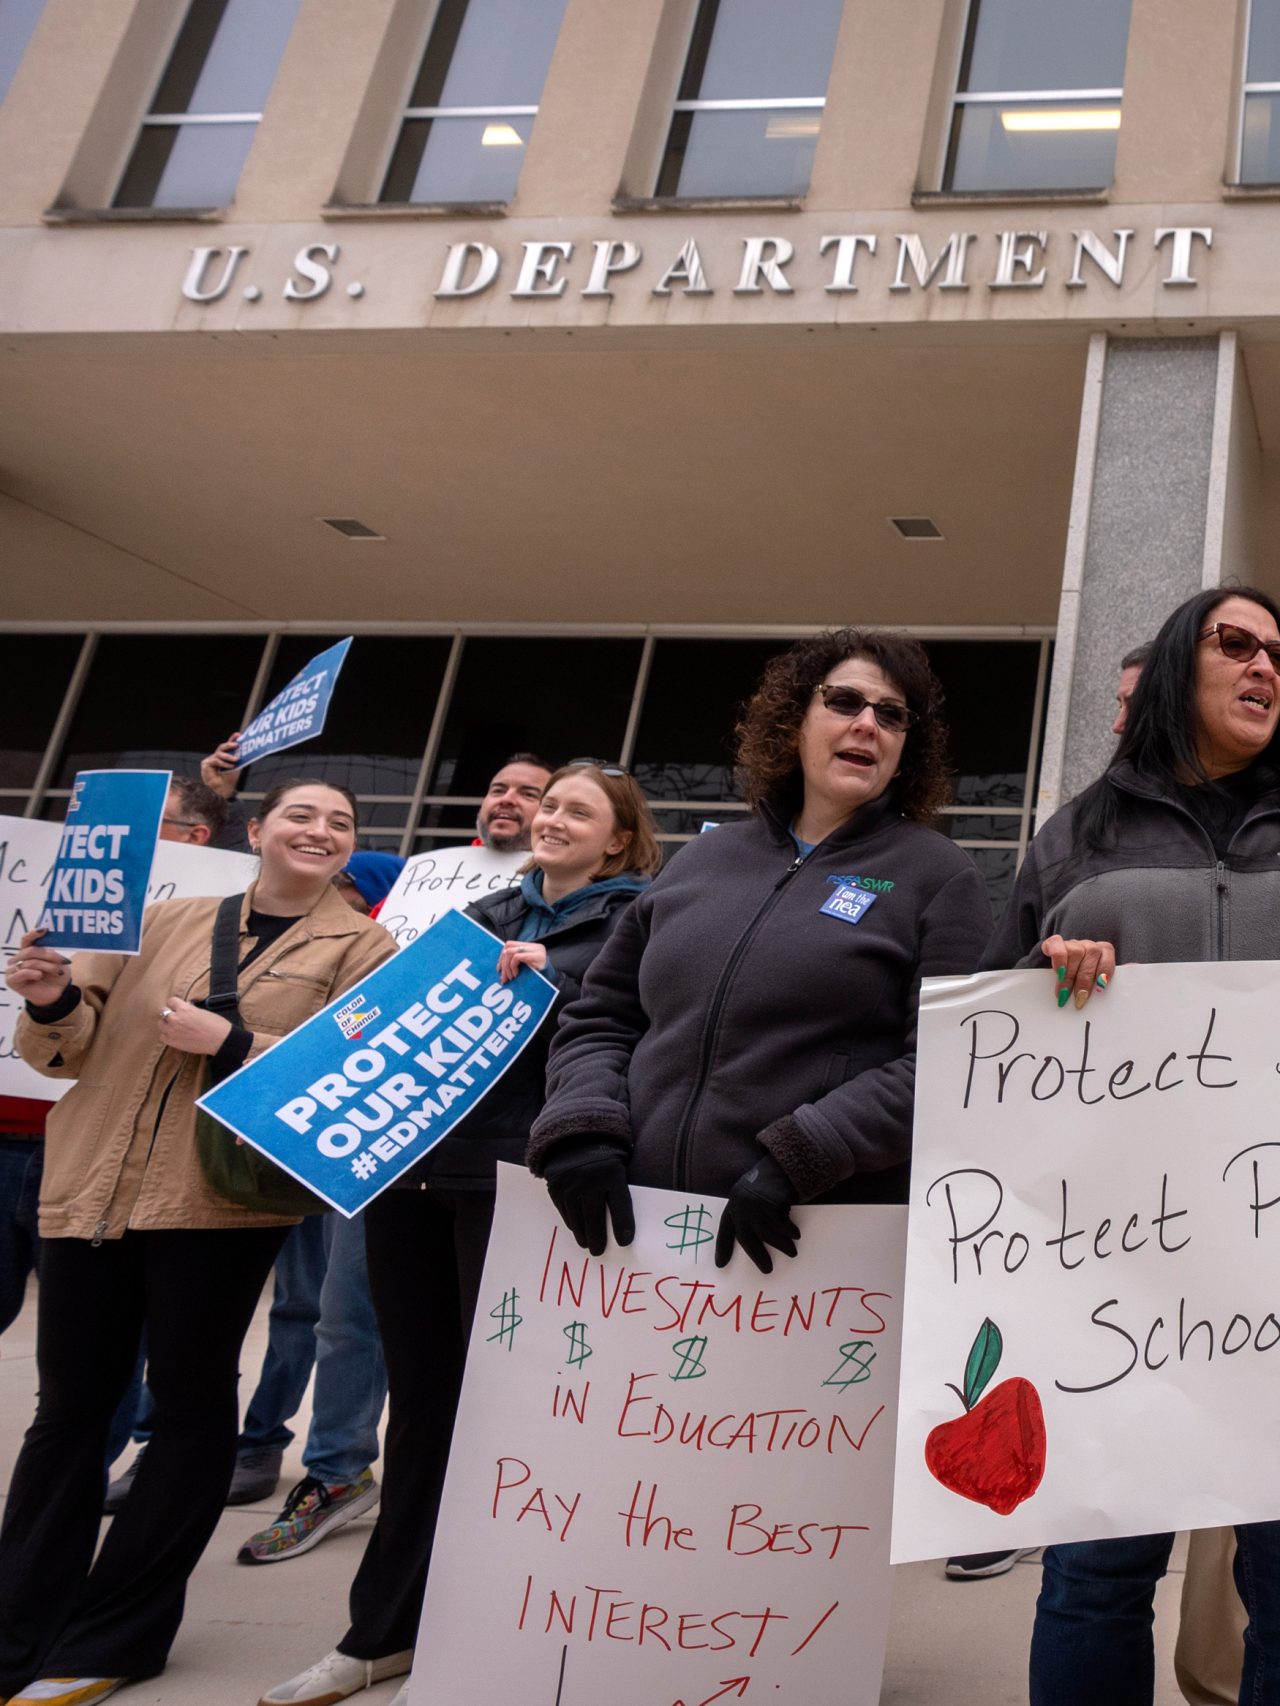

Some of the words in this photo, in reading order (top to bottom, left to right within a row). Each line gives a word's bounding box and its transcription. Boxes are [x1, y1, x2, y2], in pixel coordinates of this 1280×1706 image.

[181, 243, 366, 301] U.S.
[432, 225, 1215, 301] DEPARTMENT
[274, 693, 319, 727] KIDS
[59, 825, 130, 860] TECT
[52, 868, 125, 904] KIDS
[829, 898, 861, 917] nea
[836, 886, 846, 897] I
[842, 889, 855, 901] am
[856, 893, 871, 906] the
[39, 909, 123, 935] ATTERS
[336, 996, 364, 1020] COLOR
[341, 1016, 352, 1028] OF
[346, 1008, 379, 1036] CHANGE
[274, 958, 481, 1135] PROTECT
[317, 1072, 428, 1159] OUR
[413, 982, 514, 1078] KIDS
[960, 1008, 1238, 1109] Protect
[350, 1000, 533, 1181] #EDMATTERS
[926, 1168, 1192, 1284] Protect
[539, 1226, 893, 1336] INVESTMENTS
[617, 1372, 886, 1454] EDUCATION
[491, 1457, 582, 1542] PAY
[618, 1480, 697, 1551] the
[726, 1503, 870, 1559] BEST
